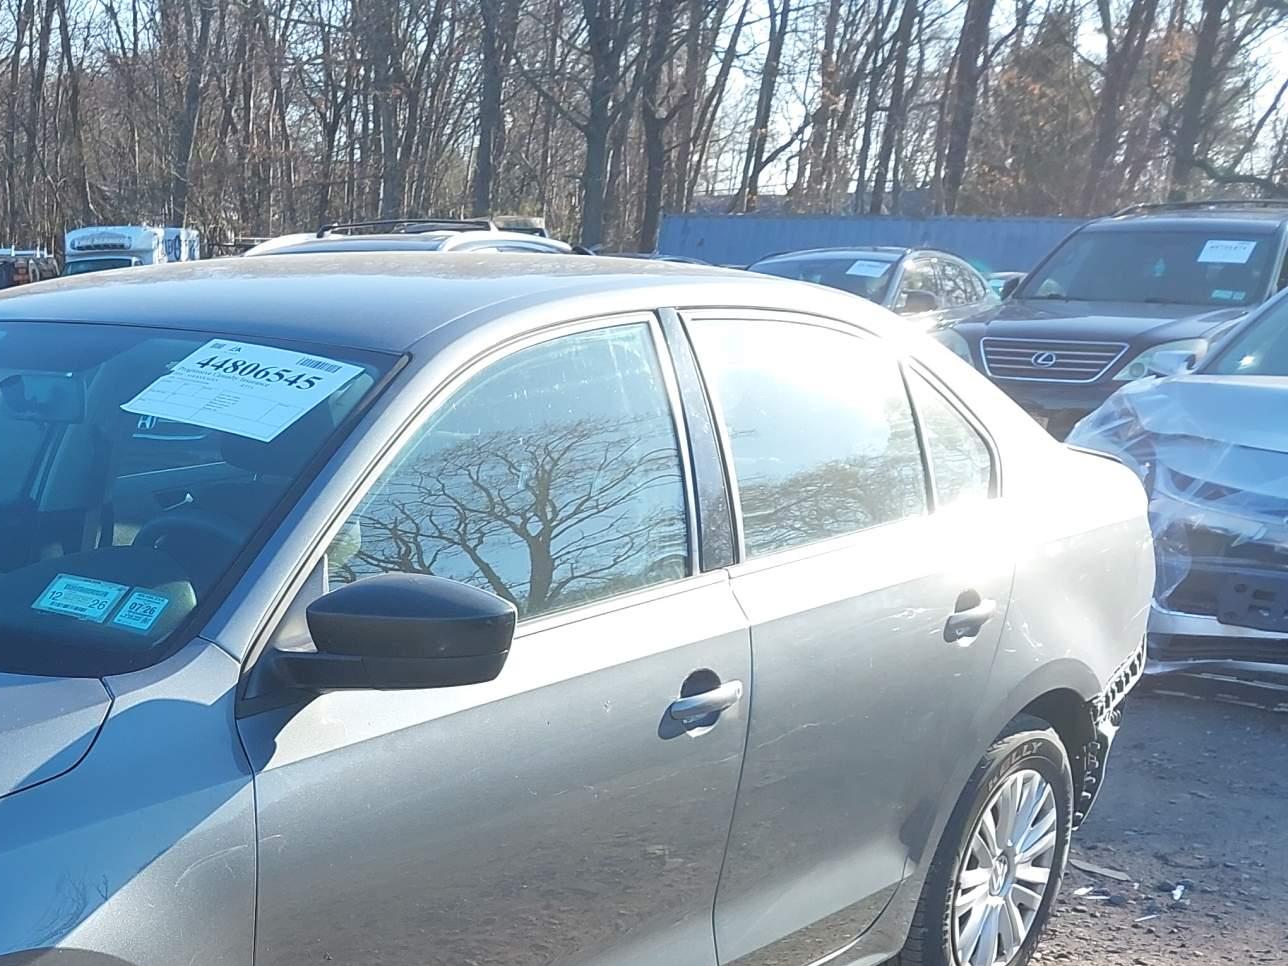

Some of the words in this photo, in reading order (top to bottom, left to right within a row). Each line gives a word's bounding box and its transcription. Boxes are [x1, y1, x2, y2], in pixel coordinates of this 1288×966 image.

[196, 355, 324, 390] 44806545
[48, 590, 63, 601] 12
[88, 598, 108, 610] 26
